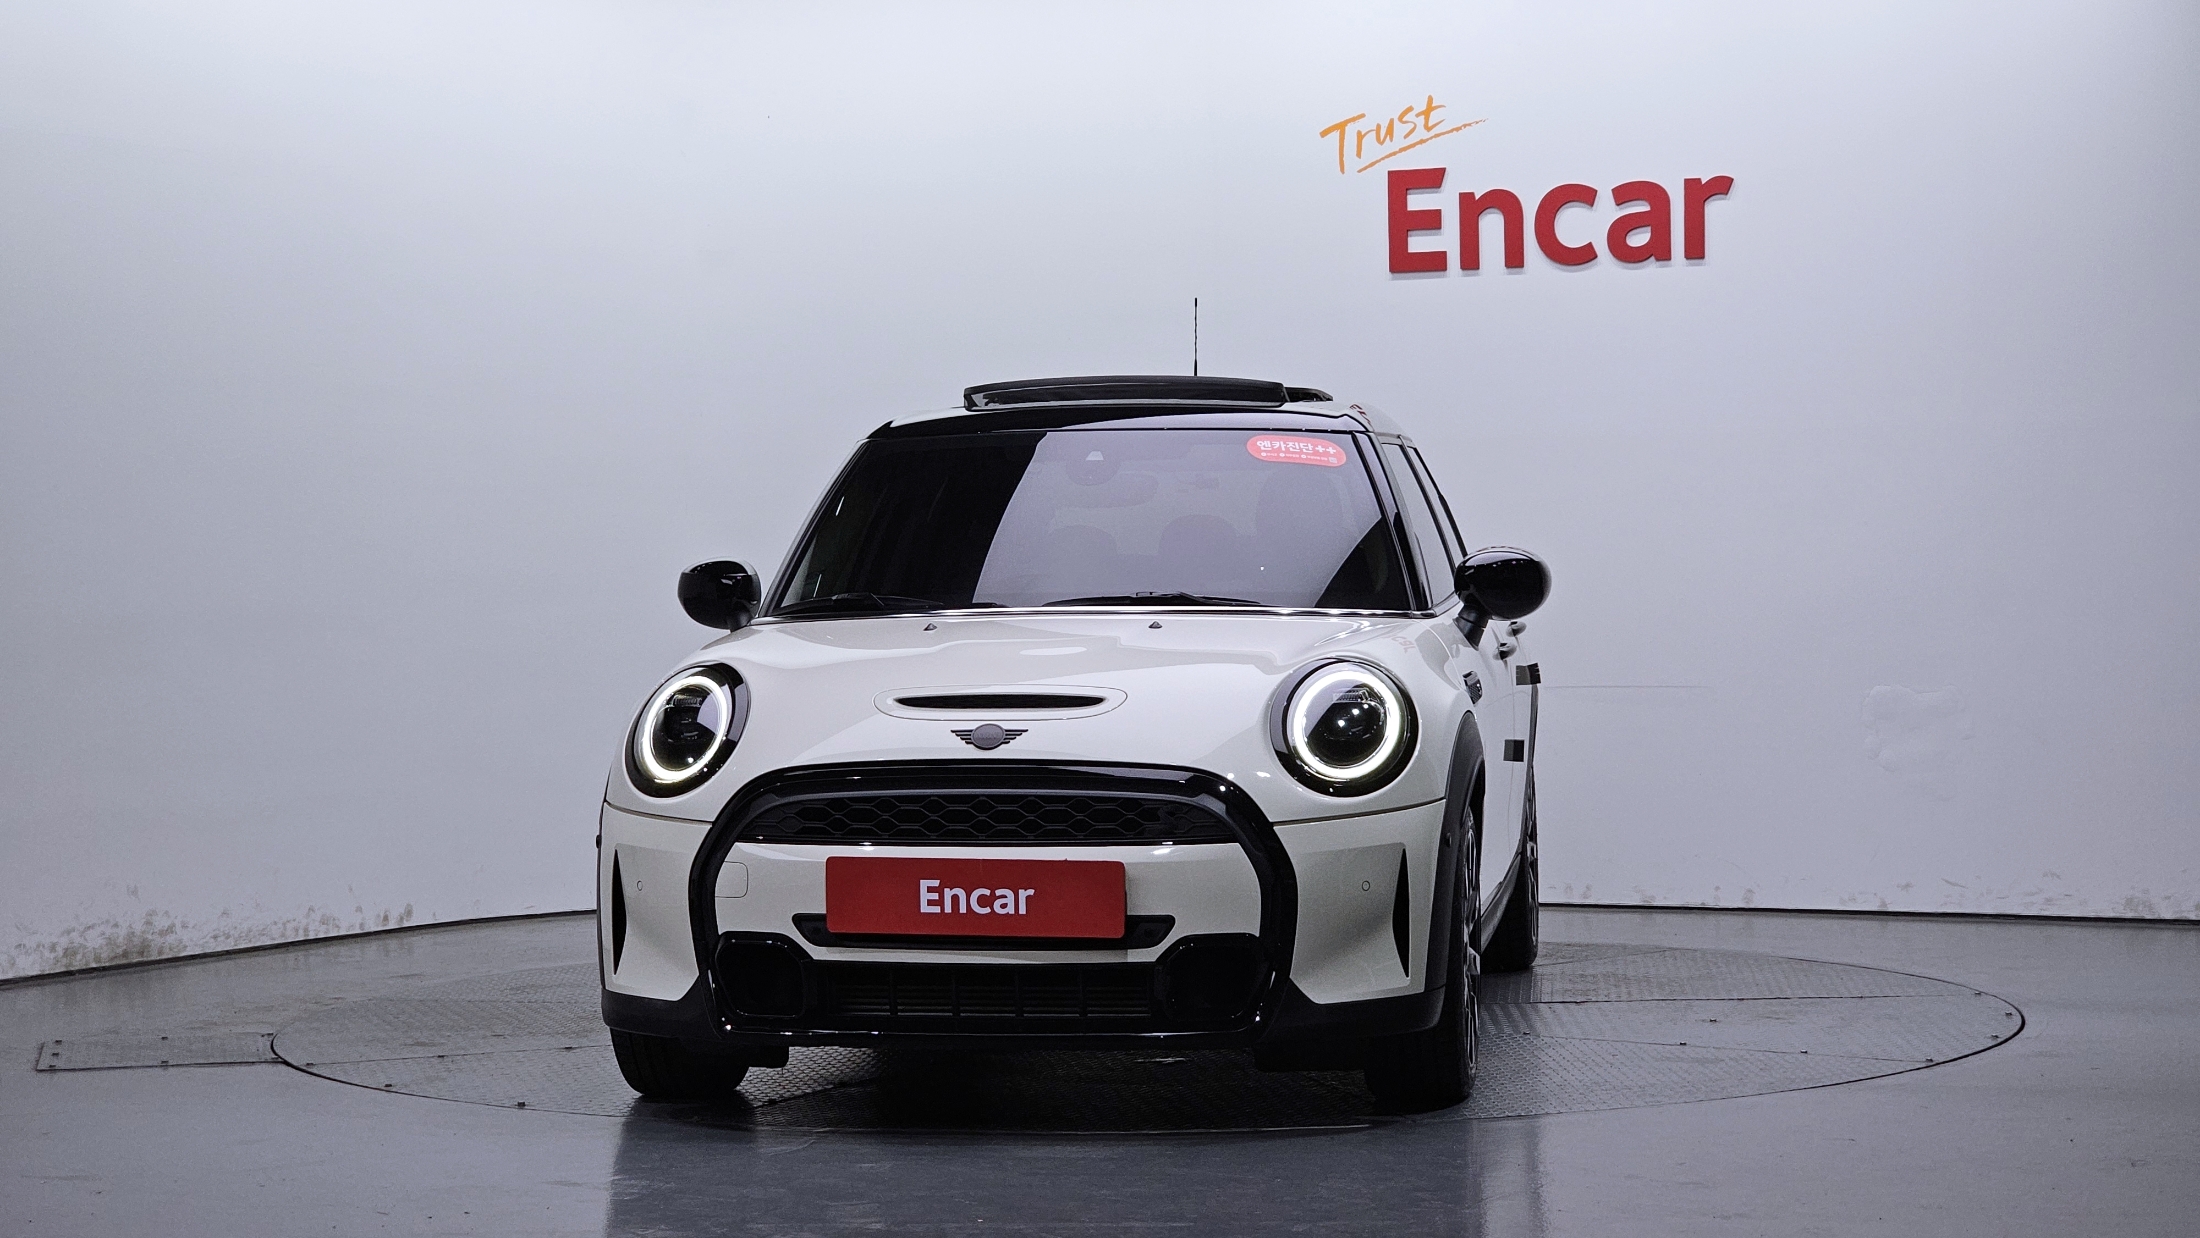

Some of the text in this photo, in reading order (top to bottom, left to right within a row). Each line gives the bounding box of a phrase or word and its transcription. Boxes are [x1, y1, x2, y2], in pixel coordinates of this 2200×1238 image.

[1319, 94, 1447, 174] Trust
[1388, 167, 1734, 273] Encar
[918, 879, 1035, 915] Encar
